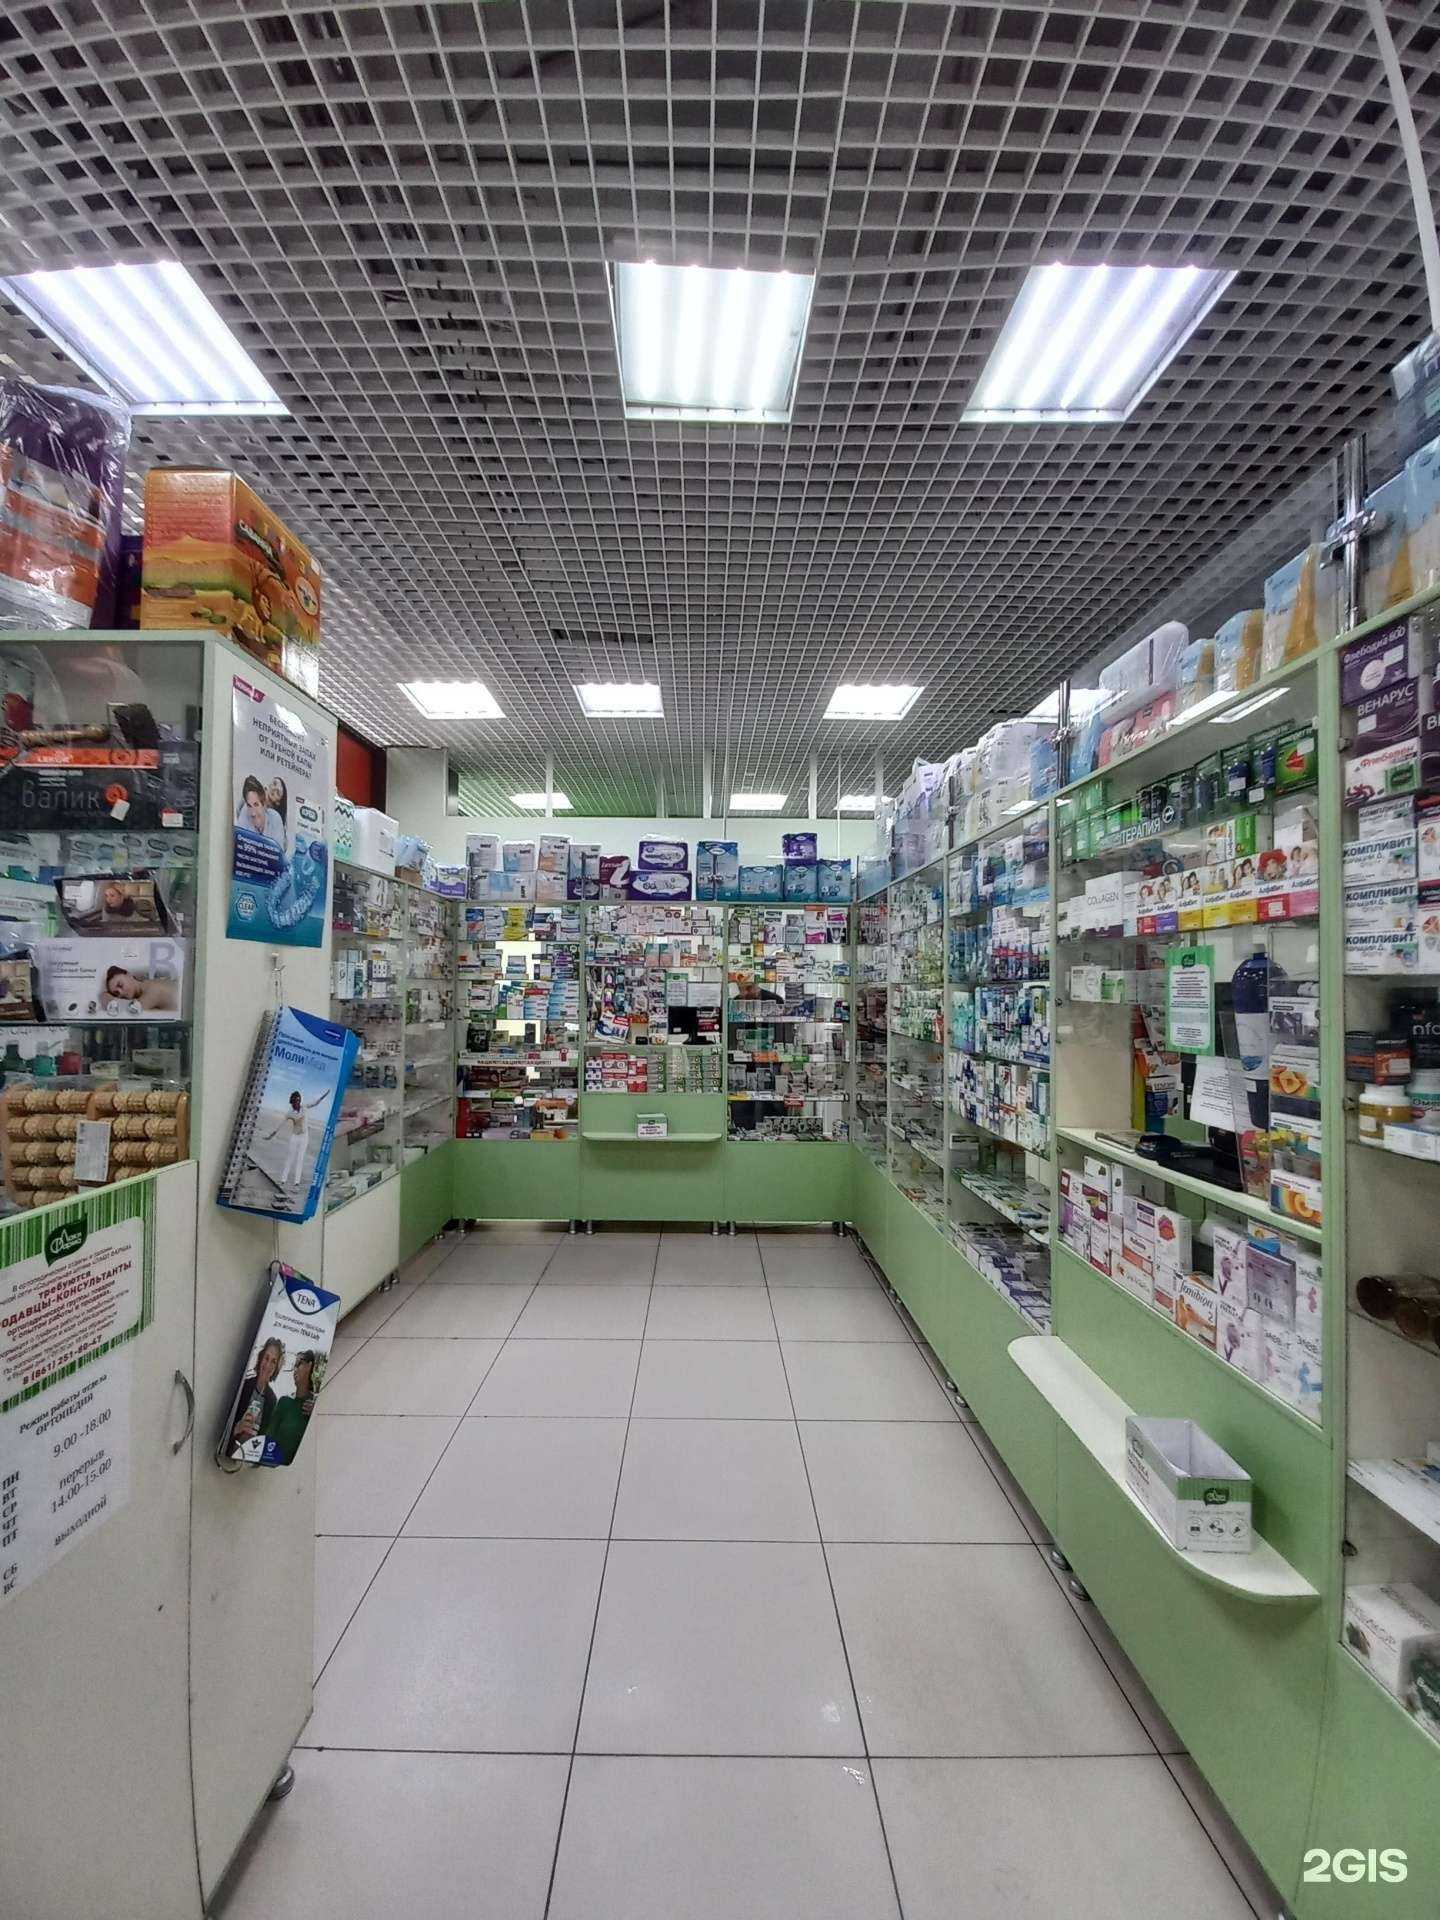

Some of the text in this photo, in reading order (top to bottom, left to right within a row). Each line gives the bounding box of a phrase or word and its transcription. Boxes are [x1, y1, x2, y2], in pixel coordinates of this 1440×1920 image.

[1357, 683, 1415, 716] ВЕНАРУС
[258, 734, 269, 744] ОТ
[259, 747, 275, 761] ИЛИ
[1120, 818, 1161, 845] ТЕРАПИЯ
[1343, 836, 1414, 858] КОМПЛИВИТ
[1345, 885, 1414, 902] КОМПЛИВИТ
[1345, 933, 1416, 945] КОМПЛИВИТ
[0, 1261, 132, 1328] ОДАВЦЫ-КОНСУЛЬТАНТЫ
[38, 1270, 92, 1300] требуются
[297, 1293, 316, 1308] TENA
[19, 1374, 107, 1434] Режим работы отдела
[36, 1393, 93, 1437] ОРТОПЕДИЯ
[53, 1432, 77, 1458] 9.00
[59, 1449, 105, 1490] перерыв
[50, 1458, 112, 1515] 14.00-15.00
[2, 1502, 18, 1519] СР
[54, 1494, 107, 1547] выходной
